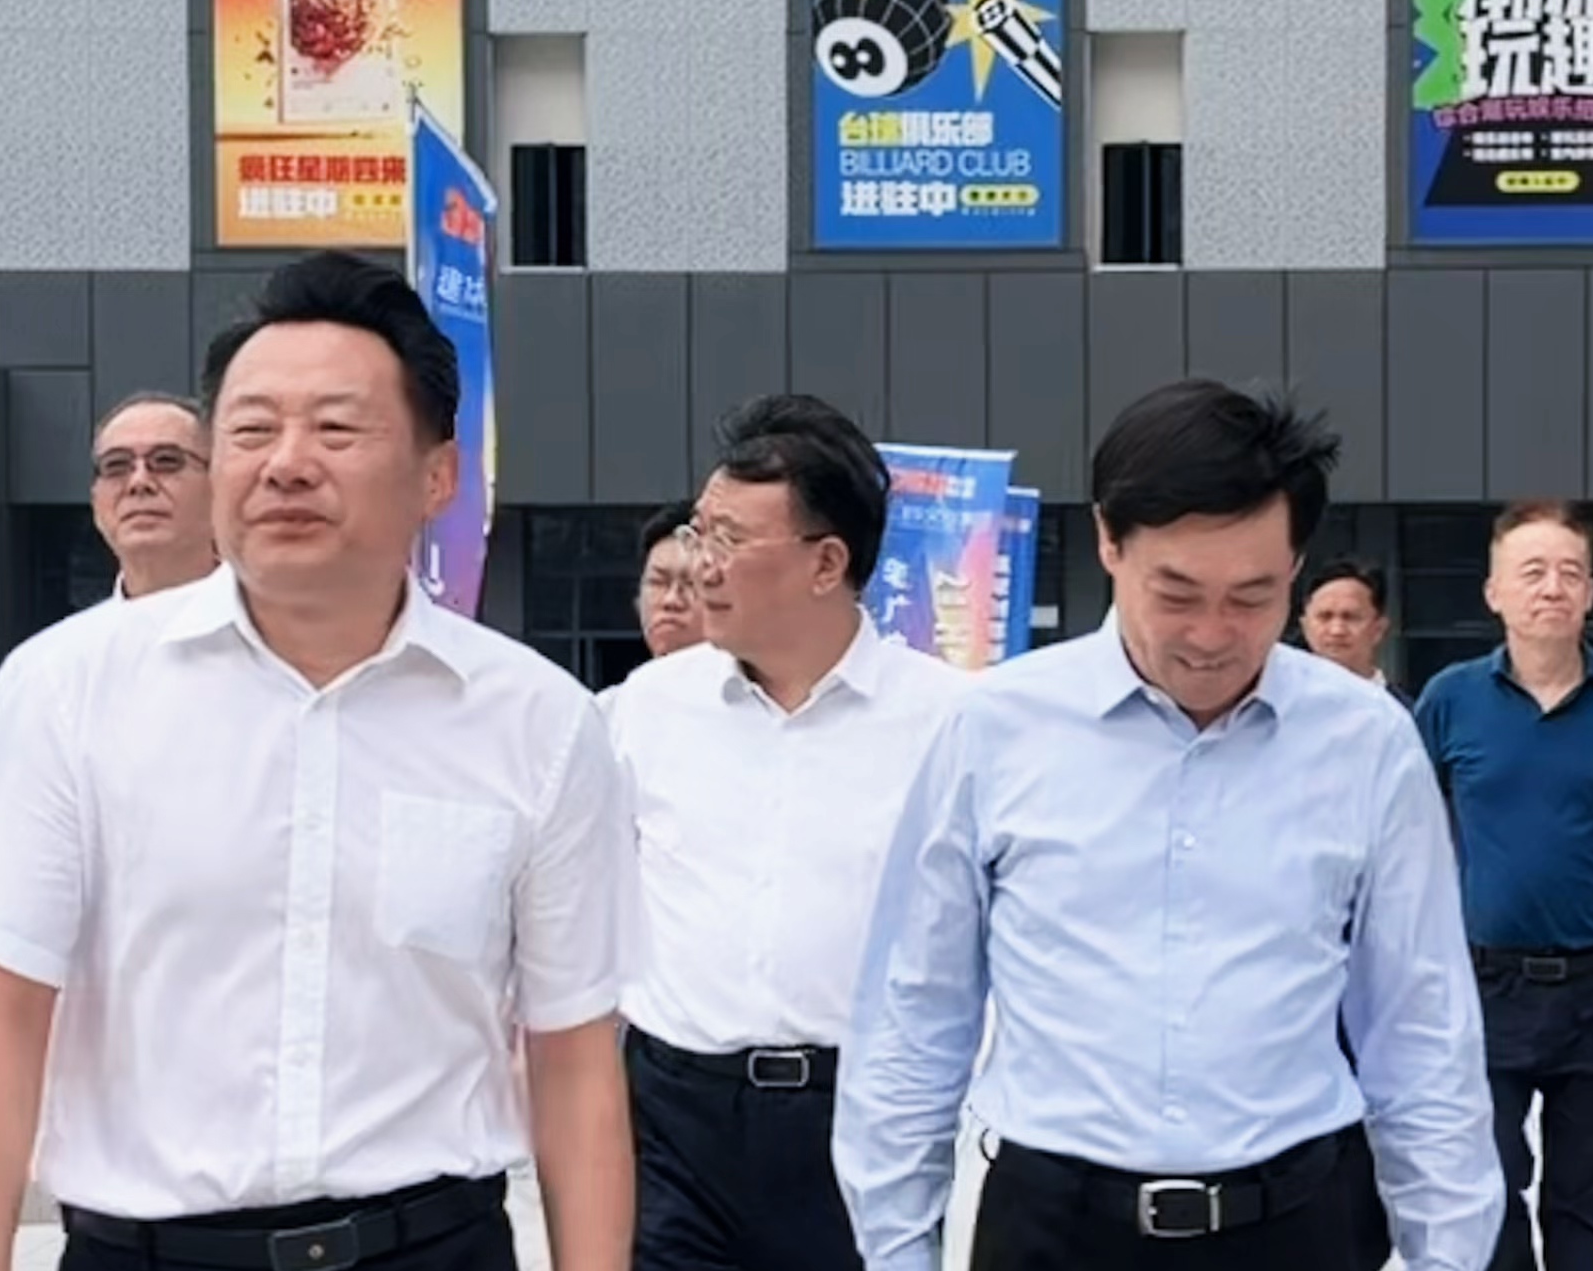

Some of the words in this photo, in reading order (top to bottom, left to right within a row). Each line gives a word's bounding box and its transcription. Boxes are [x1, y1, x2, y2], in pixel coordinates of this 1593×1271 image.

[840, 149, 953, 176] BILLIARD
[958, 149, 1032, 176] CLUB
[840, 181, 957, 216] 进驻中
